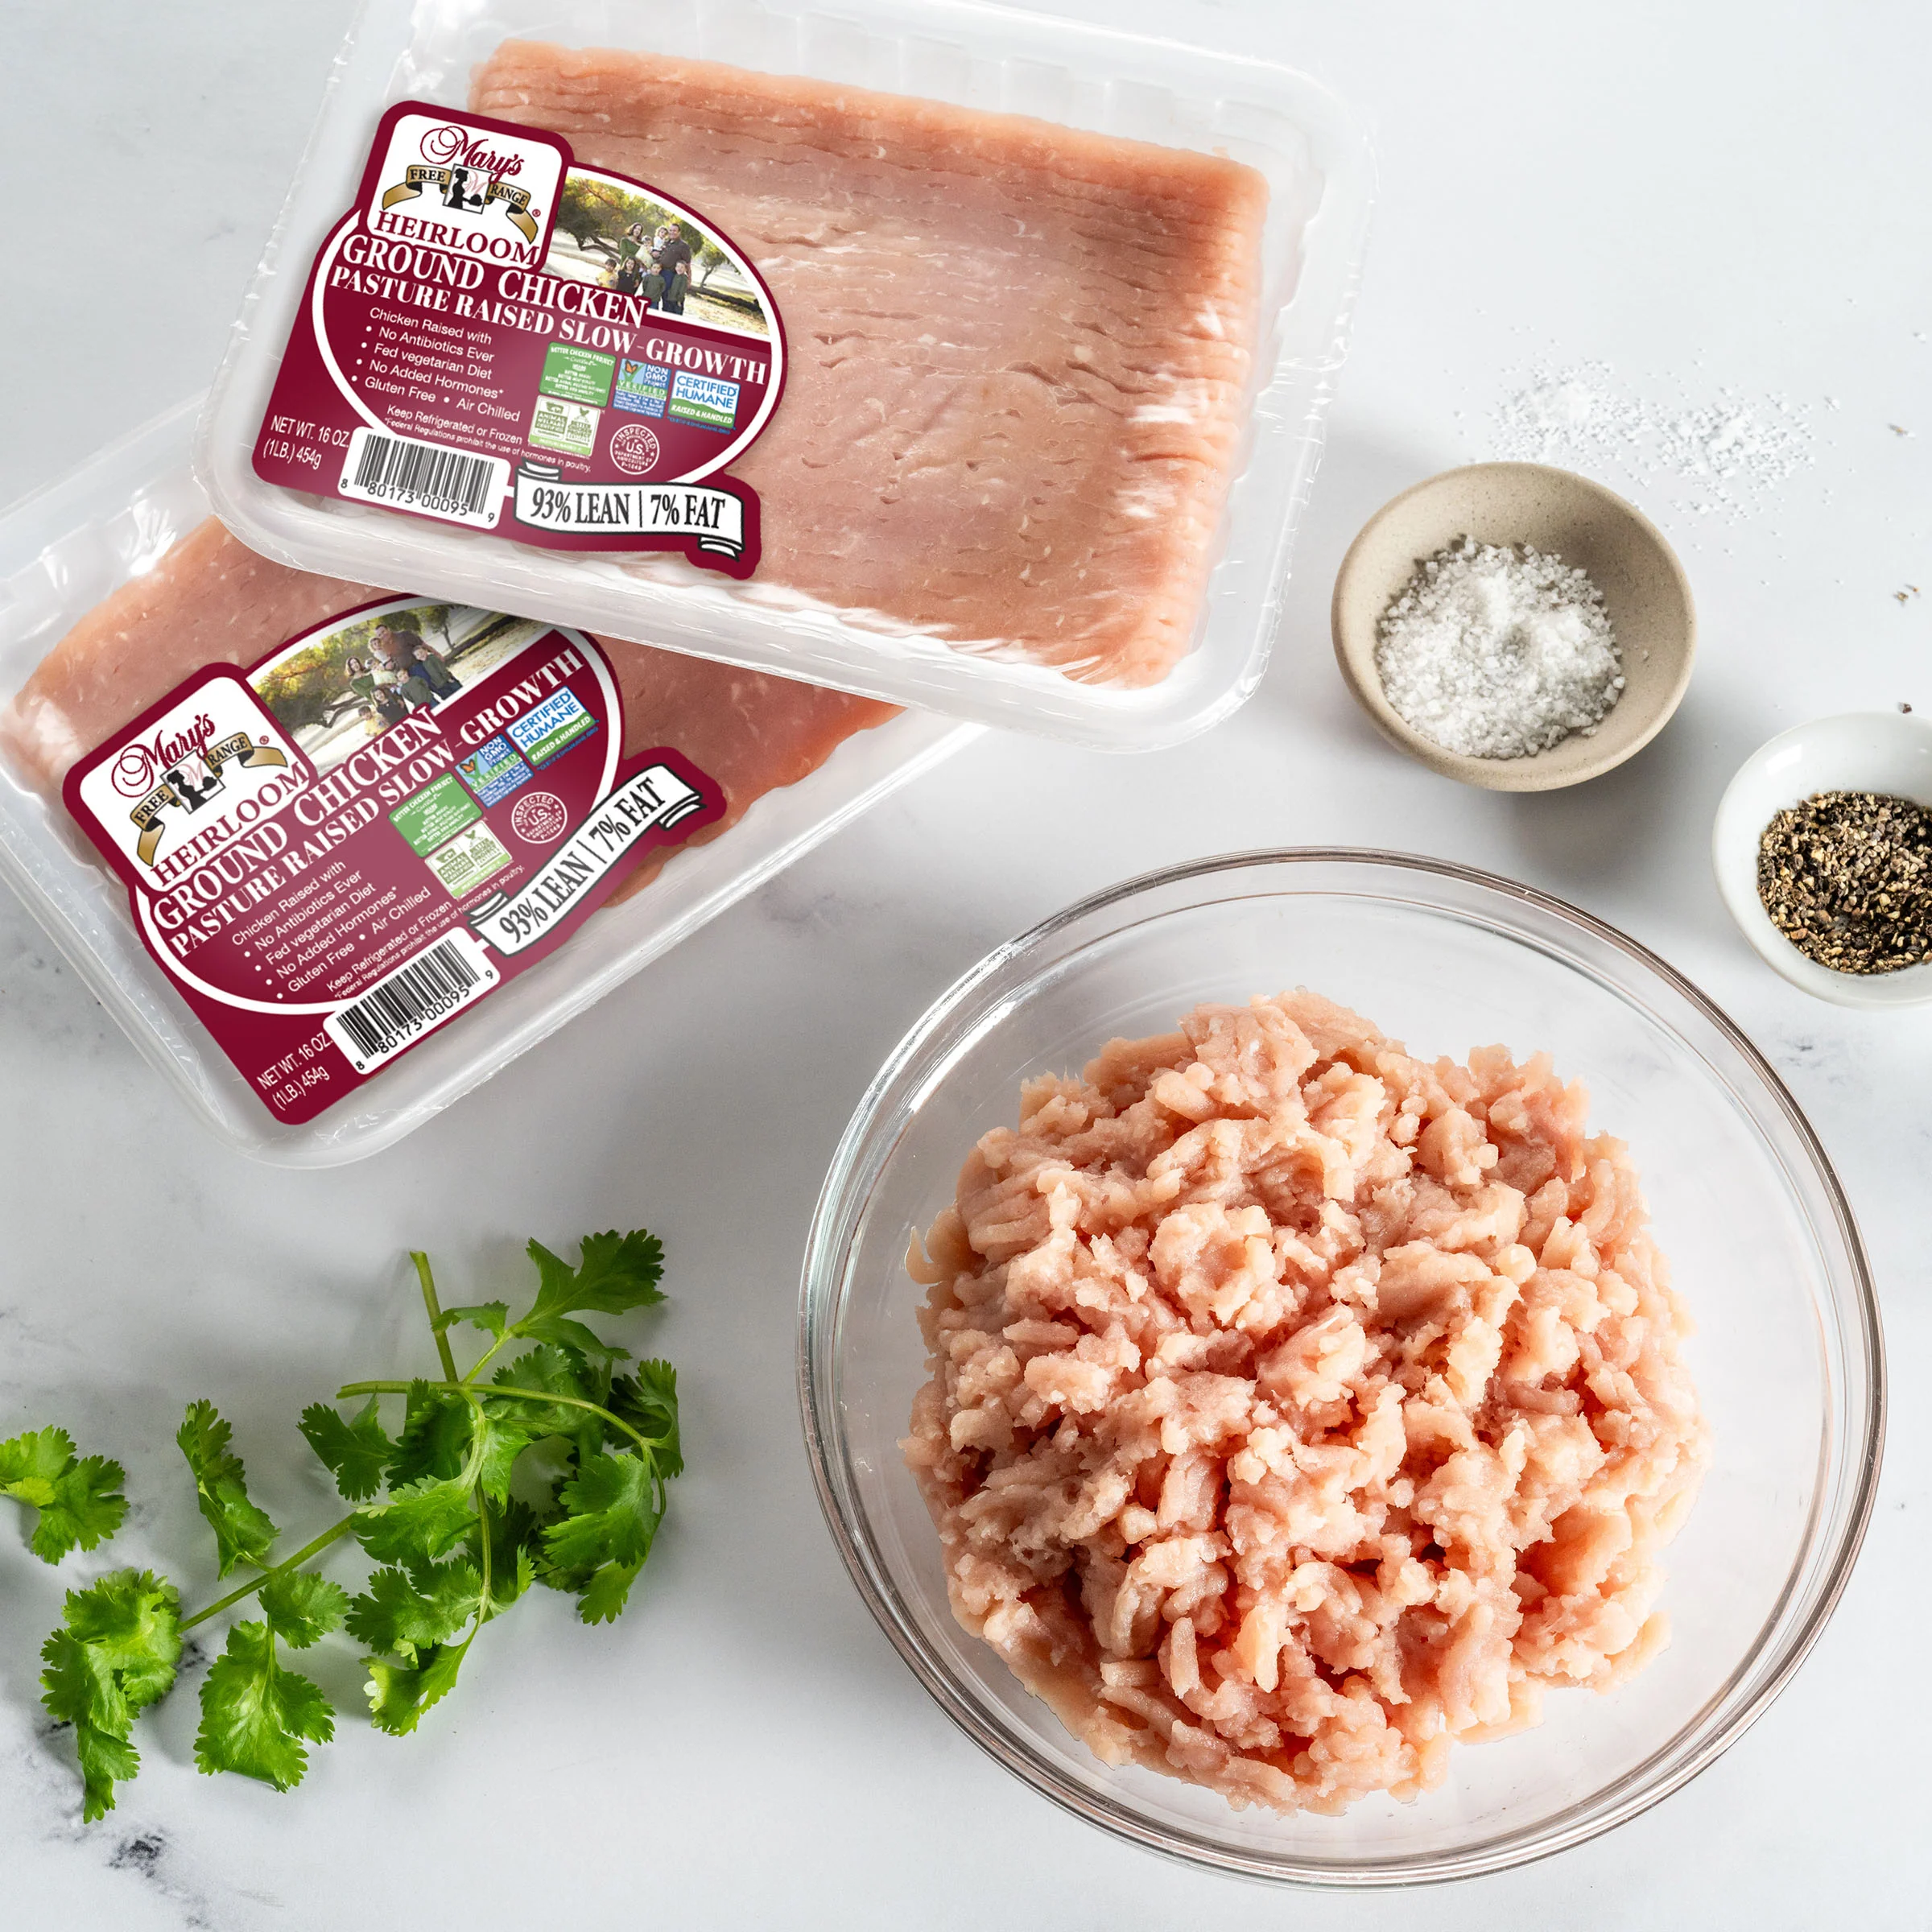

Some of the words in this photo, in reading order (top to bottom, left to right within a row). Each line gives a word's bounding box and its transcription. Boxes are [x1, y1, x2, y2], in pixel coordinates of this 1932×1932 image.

[409, 167, 445, 181] FREE
[490, 183, 527, 205] RANGE
[374, 209, 540, 266] HEIRLOOM
[329, 264, 452, 312] PASTURE
[452, 292, 556, 336] RAISED
[340, 231, 487, 292] GROUND
[494, 267, 648, 328] CHICKEN
[369, 306, 420, 328] Chicken
[421, 318, 464, 338] Raised
[465, 328, 493, 345] with
[378, 326, 398, 340] No
[398, 331, 465, 356] Antibiotics
[466, 346, 495, 362] Ever
[369, 359, 389, 374] No
[390, 364, 432, 383] Added
[373, 342, 398, 358] Fed
[399, 349, 464, 375] vegetarian
[466, 364, 493, 380] Diet
[645, 371, 667, 382] GMO
[646, 364, 669, 375] NON
[363, 375, 406, 395] Gluten
[407, 386, 437, 402] Free
[456, 397, 476, 411] Air
[477, 402, 521, 422] Chilled
[675, 386, 735, 409] HUMANE
[676, 374, 737, 398] CERTIFIED
[270, 415, 296, 435] NET
[295, 420, 316, 440] WT.
[316, 425, 332, 443] 16
[330, 428, 353, 448] OZ.
[386, 404, 414, 421] Keep
[414, 411, 475, 436] Refrigerated
[476, 427, 488, 436] or
[488, 427, 523, 445] Frozen
[671, 403, 696, 415] RAISED
[700, 411, 733, 424] HANDLED
[262, 438, 296, 463] (1LB.)
[294, 445, 323, 470] 454g
[414, 424, 456, 442] Regulations
[456, 434, 484, 448] prohibit
[484, 440, 497, 450] the
[497, 445, 510, 453] use
[511, 447, 520, 455] of
[520, 449, 556, 464] hormones
[557, 457, 565, 465] in
[616, 427, 655, 448] INSPECTED
[340, 477, 349, 489] 8
[367, 481, 416, 504] 80173
[420, 493, 469, 516] 00095
[486, 512, 495, 522] 9
[530, 487, 572, 522] 93%
[575, 492, 630, 524] LEAN
[650, 494, 680, 524] 7%
[684, 496, 725, 529] FAT
[510, 690, 572, 740] CERTIFIED
[519, 700, 580, 749] HUMANE
[206, 736, 249, 765] RANGE
[478, 735, 502, 755] NON
[484, 741, 507, 762] GMO
[530, 740, 556, 762] RAISED
[559, 715, 592, 741] HANDLED
[134, 789, 169, 824] FREE
[147, 816, 293, 934] GROUND
[288, 705, 442, 832] CHICKEN
[149, 761, 310, 887] HEIRLOOM
[514, 795, 553, 826] INSPECTED
[167, 863, 287, 958] PASTURE
[279, 793, 383, 877] RAISED
[498, 897, 548, 943] 93%
[532, 850, 594, 913] LEAN
[589, 814, 631, 852] 7%
[614, 776, 665, 827] FAT
[229, 906, 280, 947] Chicken
[277, 877, 320, 913] Raised
[317, 858, 346, 884] with
[254, 931, 275, 952] No
[272, 888, 336, 938] Antibiotics
[333, 868, 363, 894] Ever
[264, 942, 291, 965] Fed
[288, 899, 353, 950] vegetarian
[349, 881, 377, 905] Diet
[286, 960, 328, 993] Gluten
[325, 939, 356, 965] Free
[369, 914, 390, 935] Air
[387, 885, 431, 921] Chilled
[325, 969, 354, 994] Keep
[351, 930, 410, 976] Refrigerated
[407, 923, 420, 935] or
[417, 898, 452, 927] Frozen
[361, 951, 402, 983] Regulations
[398, 933, 427, 956] prohibit
[423, 924, 438, 937] the
[436, 916, 451, 928] use
[448, 910, 459, 919] of
[456, 886, 492, 914] hormones
[490, 881, 500, 890] in
[275, 960, 297, 979] No
[294, 931, 336, 966] Added
[354, 1059, 365, 1071] 8
[376, 1016, 423, 1055] 80173
[423, 983, 471, 1022] 00095
[484, 969, 495, 980] 9
[256, 1064, 284, 1090] NET
[277, 1052, 302, 1075] WT.
[296, 1042, 316, 1062] 16
[308, 1030, 333, 1053] OZ.
[270, 1079, 308, 1111] (1LB.)
[298, 1063, 331, 1092] 454g
